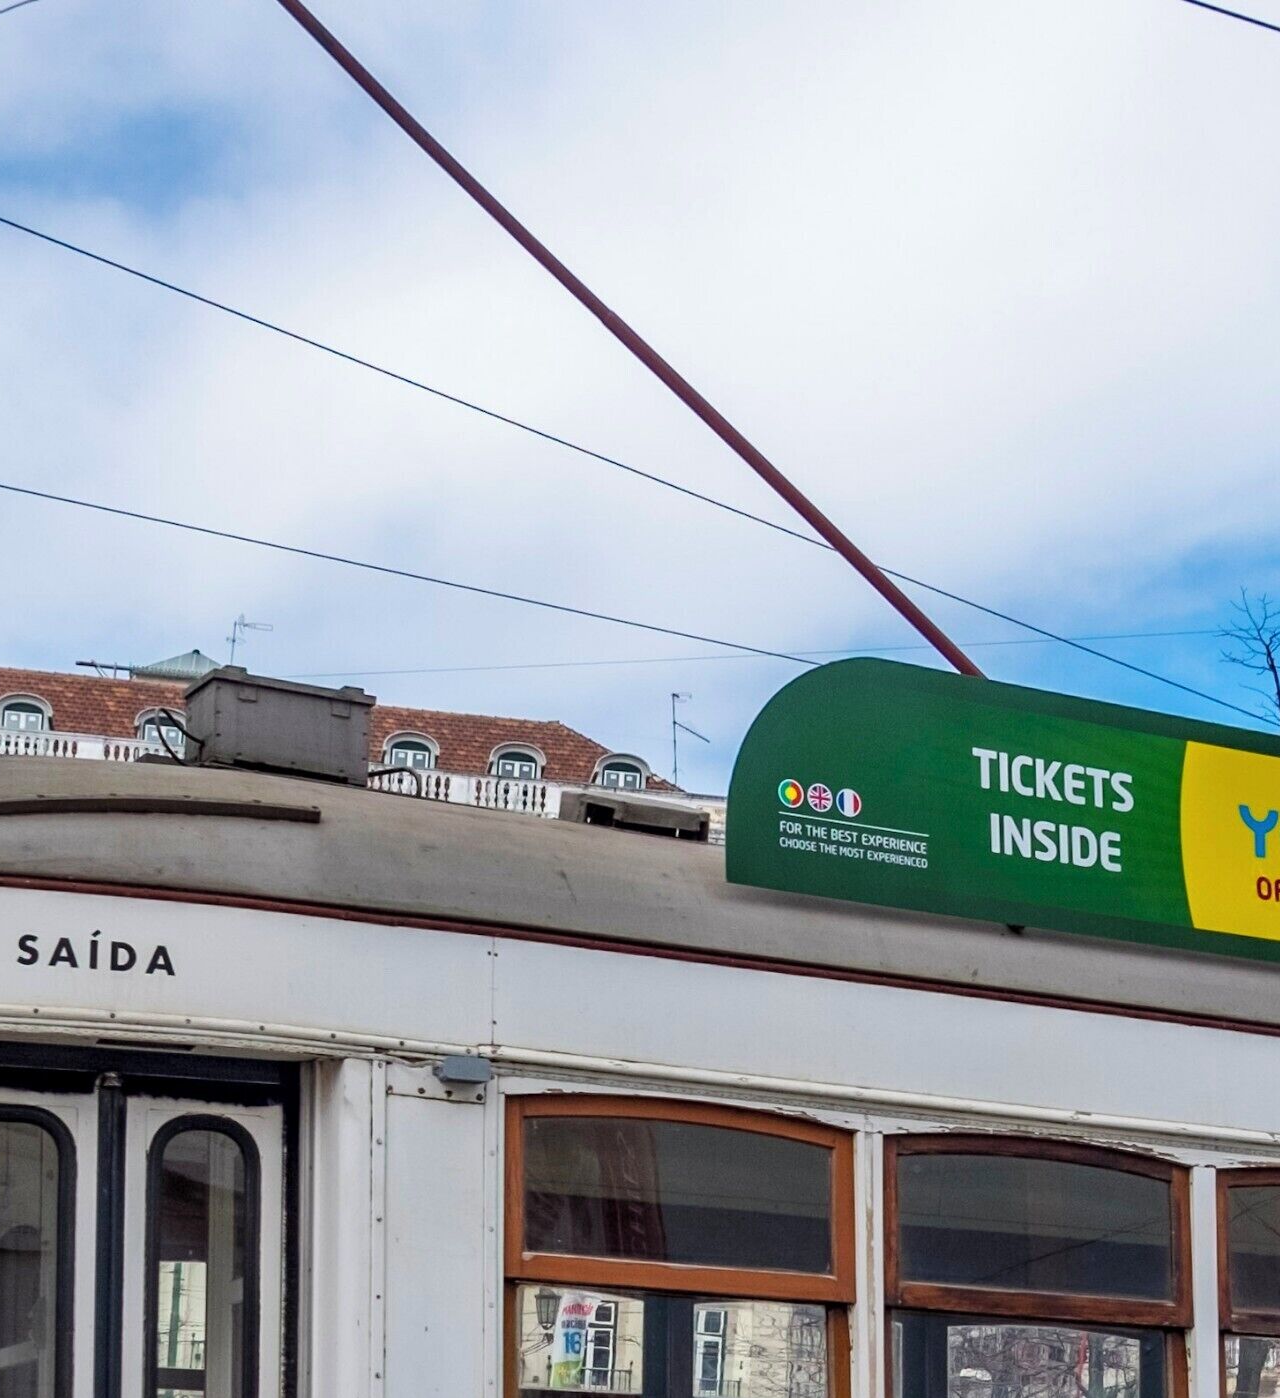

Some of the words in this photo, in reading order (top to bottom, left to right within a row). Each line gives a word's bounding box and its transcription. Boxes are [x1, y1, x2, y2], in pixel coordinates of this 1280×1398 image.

[972, 747, 1134, 812] TICKETS
[780, 821, 802, 834] FOR
[806, 824, 827, 838] THE
[831, 829, 858, 843] BEST
[861, 834, 927, 854] EXPERIENCE
[780, 837, 817, 852] CHOOSE
[820, 843, 837, 855] THE
[839, 845, 864, 859] MOST
[867, 851, 928, 869] EXPERIENCED
[990, 813, 1122, 872] INSIDE
[17, 929, 175, 976] SAÍDA
[563, 1332, 582, 1354] 16
